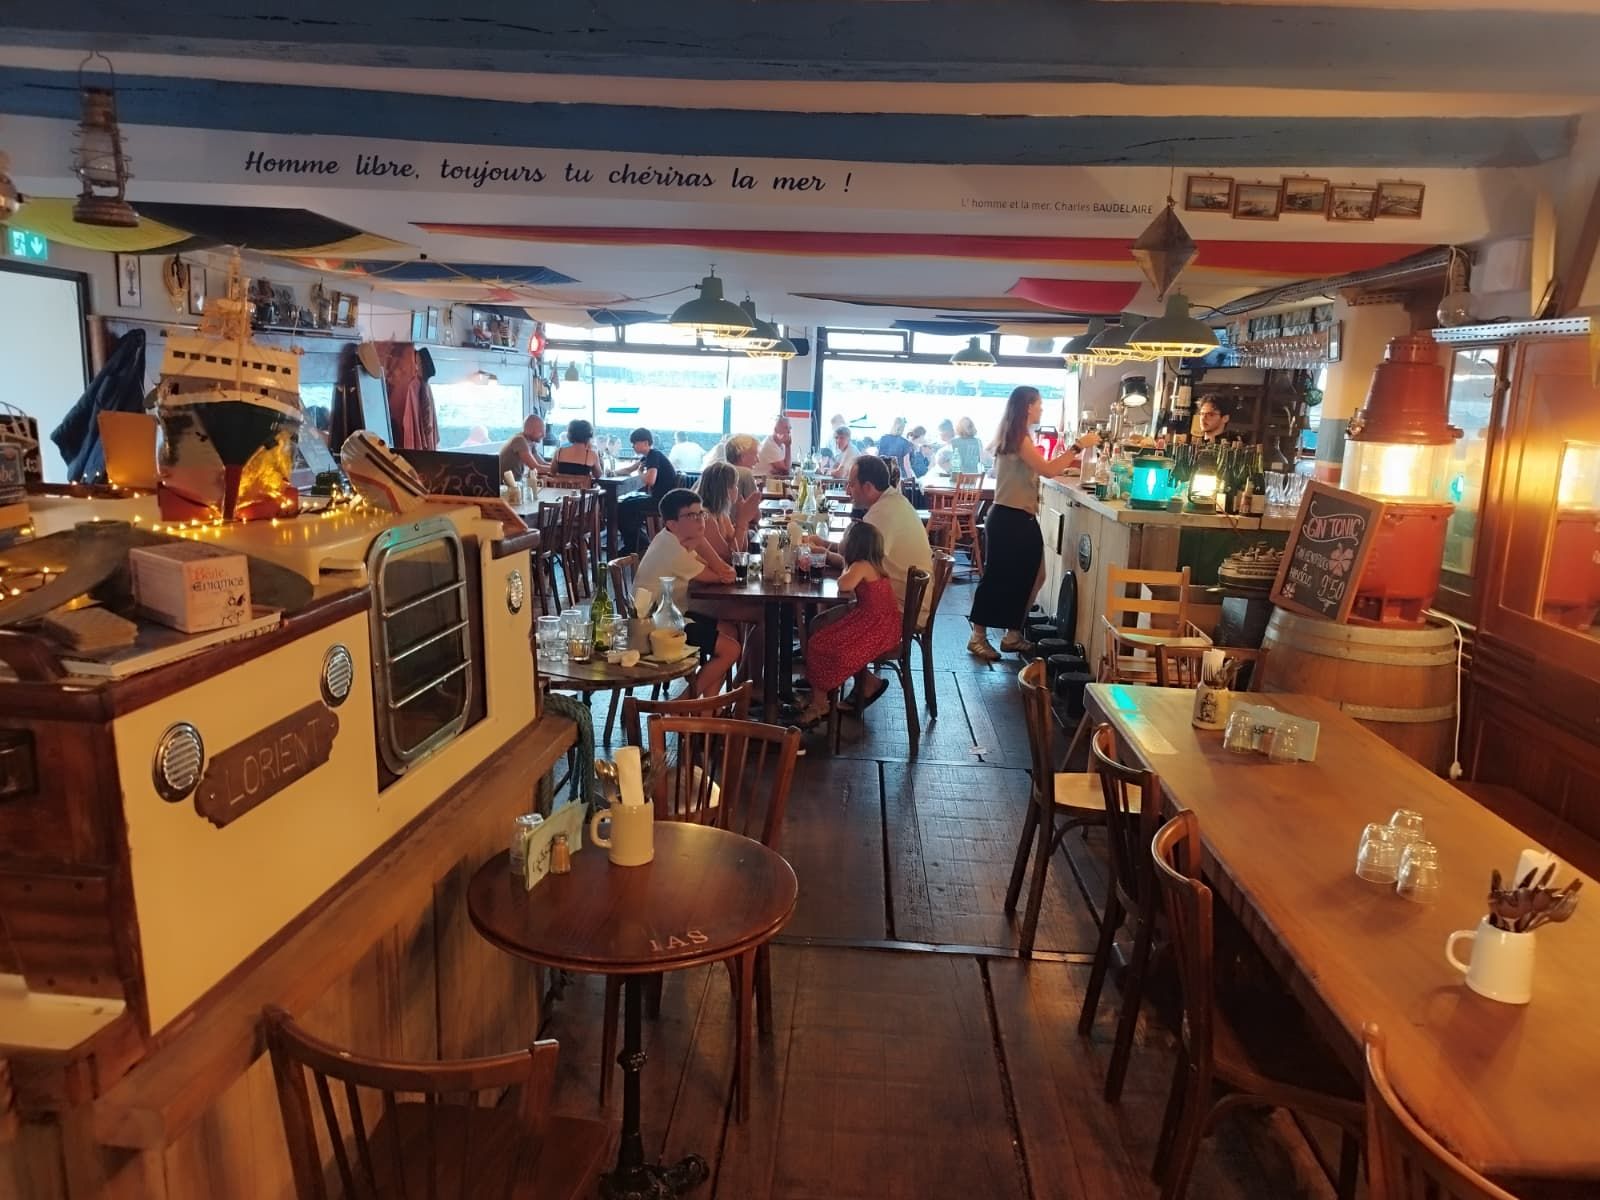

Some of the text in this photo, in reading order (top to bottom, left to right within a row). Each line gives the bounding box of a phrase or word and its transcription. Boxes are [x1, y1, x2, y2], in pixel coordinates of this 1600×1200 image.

[244, 151, 852, 192] Homme libre, toujours tu chériras la mer !
[972, 198, 1006, 208] homme
[1009, 200, 1018, 209] et
[1021, 200, 1029, 209] la
[1054, 201, 1090, 212] Charles
[1093, 203, 1152, 214] BAUDELAIRE
[1307, 518, 1361, 539] GIN TONIC
[225, 718, 320, 806] LORIENT
